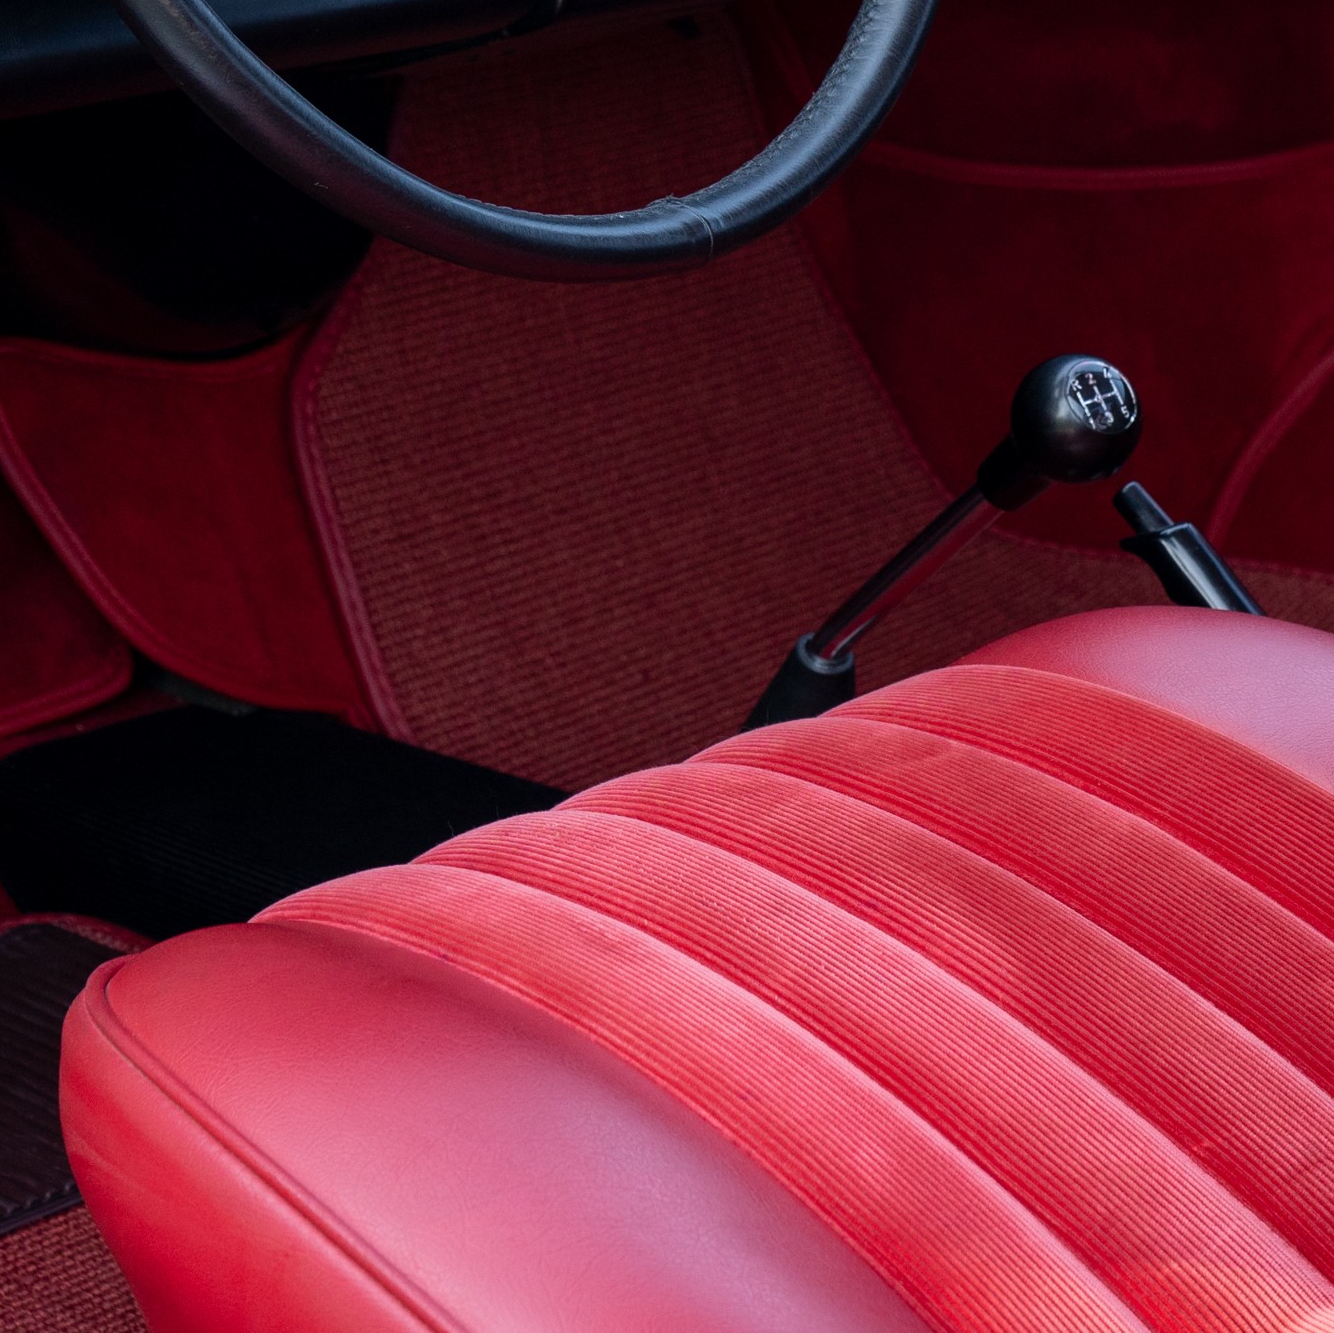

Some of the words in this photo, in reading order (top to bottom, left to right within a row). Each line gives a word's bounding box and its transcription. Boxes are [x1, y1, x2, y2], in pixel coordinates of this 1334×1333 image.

[1071, 379, 1083, 391] R
[1085, 372, 1097, 385] 2
[1120, 405, 1130, 418] 5
